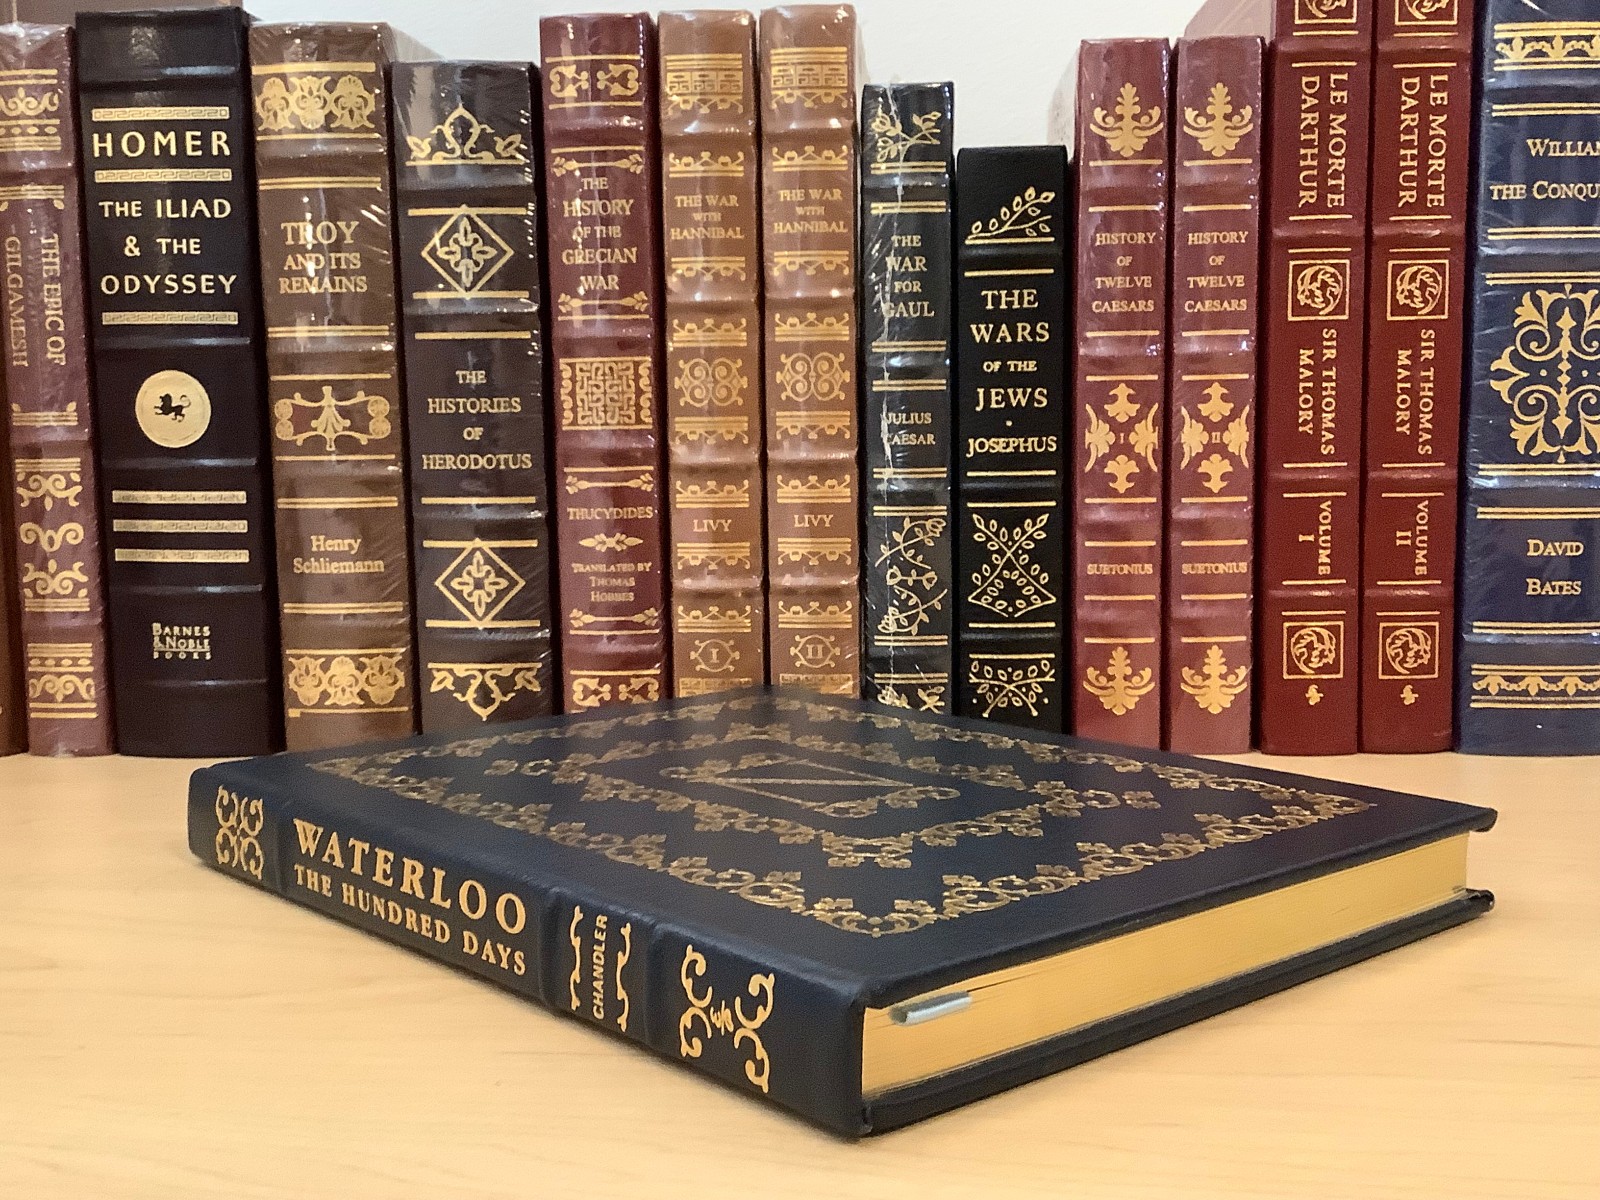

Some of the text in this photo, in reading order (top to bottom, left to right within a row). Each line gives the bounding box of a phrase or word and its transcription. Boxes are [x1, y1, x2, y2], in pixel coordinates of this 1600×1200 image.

[92, 130, 231, 158] HOMER
[1298, 75, 1320, 208] DARTHUR
[1327, 73, 1348, 208] LE MORTE
[1398, 77, 1420, 208] DARTHUR
[1427, 74, 1449, 208] LE MORTE
[581, 177, 608, 190] THE
[779, 188, 842, 201] THE WAR
[1489, 184, 1527, 200] THE
[98, 198, 232, 219] THE ILIAD
[562, 199, 634, 217] HISTORY
[674, 194, 739, 208] THE WAR
[693, 212, 721, 221] WITH
[796, 206, 825, 216] WITH
[280, 220, 360, 245] TROY
[572, 226, 621, 240] OF THE
[670, 227, 744, 240] HANNIBAL
[773, 222, 848, 233] HANNIBAL
[123, 235, 201, 257] & THE
[891, 235, 921, 247] THE
[1095, 232, 1156, 246] HISTORY
[1187, 231, 1249, 245] HISTORY
[284, 252, 361, 270] AND ITS
[562, 247, 637, 264] GRECIAN
[1116, 256, 1133, 266] OF
[1209, 255, 1225, 266] OF
[885, 256, 927, 272] WAR
[100, 274, 237, 294] ODYSSEY
[278, 276, 368, 294] REMAINS
[580, 275, 620, 290] WAR
[894, 281, 922, 293] FOR
[1095, 276, 1152, 288] TWELVE
[1187, 275, 1245, 288] TWELVE
[4, 236, 29, 367] GILGAMESH
[41, 233, 66, 366] THE EPIC OF
[981, 289, 1039, 310] THE
[1091, 300, 1155, 313] CAESARS
[1184, 299, 1247, 313] CAESARS
[883, 301, 935, 318] GAUL
[970, 322, 1050, 343] WARS
[983, 361, 1037, 372] OF THE
[455, 370, 487, 384] THE
[975, 387, 1048, 411] JEWS
[1298, 349, 1314, 435] MALORY
[1320, 328, 1337, 455] SIR THOMAS
[1396, 349, 1412, 435] MALORY
[1418, 329, 1435, 455] SIR THOMAS
[427, 397, 521, 414] HISTORIES
[882, 412, 932, 425] JULIUS
[463, 427, 484, 440] OF
[966, 437, 1058, 458] JOSEPHUS
[422, 454, 533, 470] HERODOTUS
[567, 507, 653, 520] THUCYDIDES
[794, 514, 834, 527] LIVY
[693, 520, 732, 532] LIVY
[310, 535, 362, 554] Henry
[1298, 534, 1315, 542] I
[1318, 500, 1332, 576] VOLUME
[1396, 530, 1412, 546] II
[1414, 500, 1429, 576] VOLUME
[1526, 539, 1584, 556] DAVID
[293, 557, 385, 574] Schliemann
[637, 562, 652, 572] BY
[1087, 563, 1153, 575] SUETONIUS
[1182, 562, 1247, 574] SUETONIUS
[1525, 578, 1582, 595] BATES
[152, 623, 211, 636] BARNES
[710, 648, 719, 660] I
[806, 644, 824, 659] II
[293, 818, 526, 934] WATERLOO
[294, 863, 526, 976] THE HUNDRED DAYS
[592, 914, 607, 1020] CHANDLER
